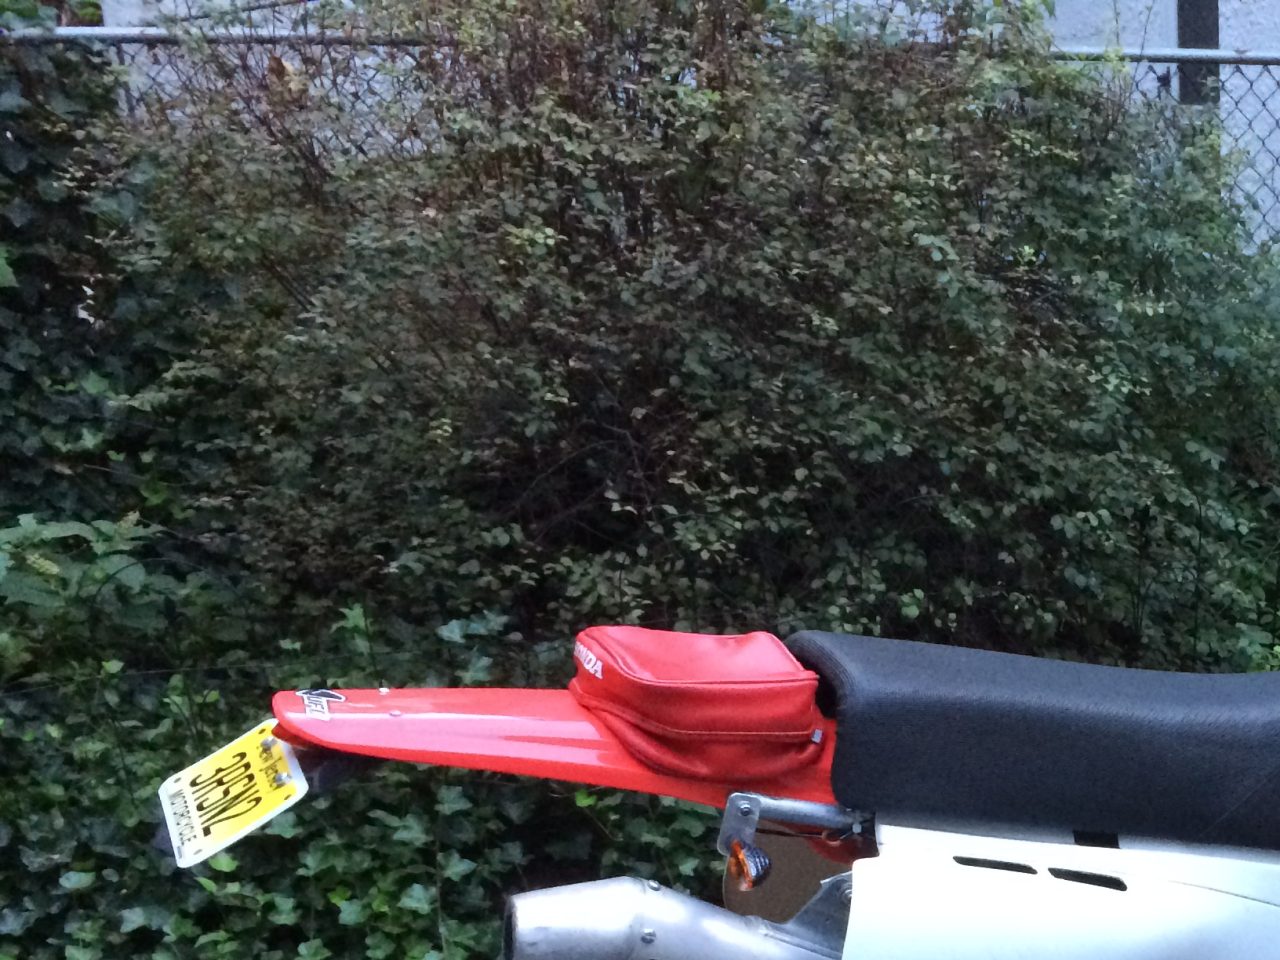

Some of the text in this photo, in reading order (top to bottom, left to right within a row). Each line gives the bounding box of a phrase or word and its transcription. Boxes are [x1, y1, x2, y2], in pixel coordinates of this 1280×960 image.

[574, 641, 603, 679] ONDA
[169, 789, 197, 846] MOTORCYCLE
[189, 752, 262, 837] 3RSN2
